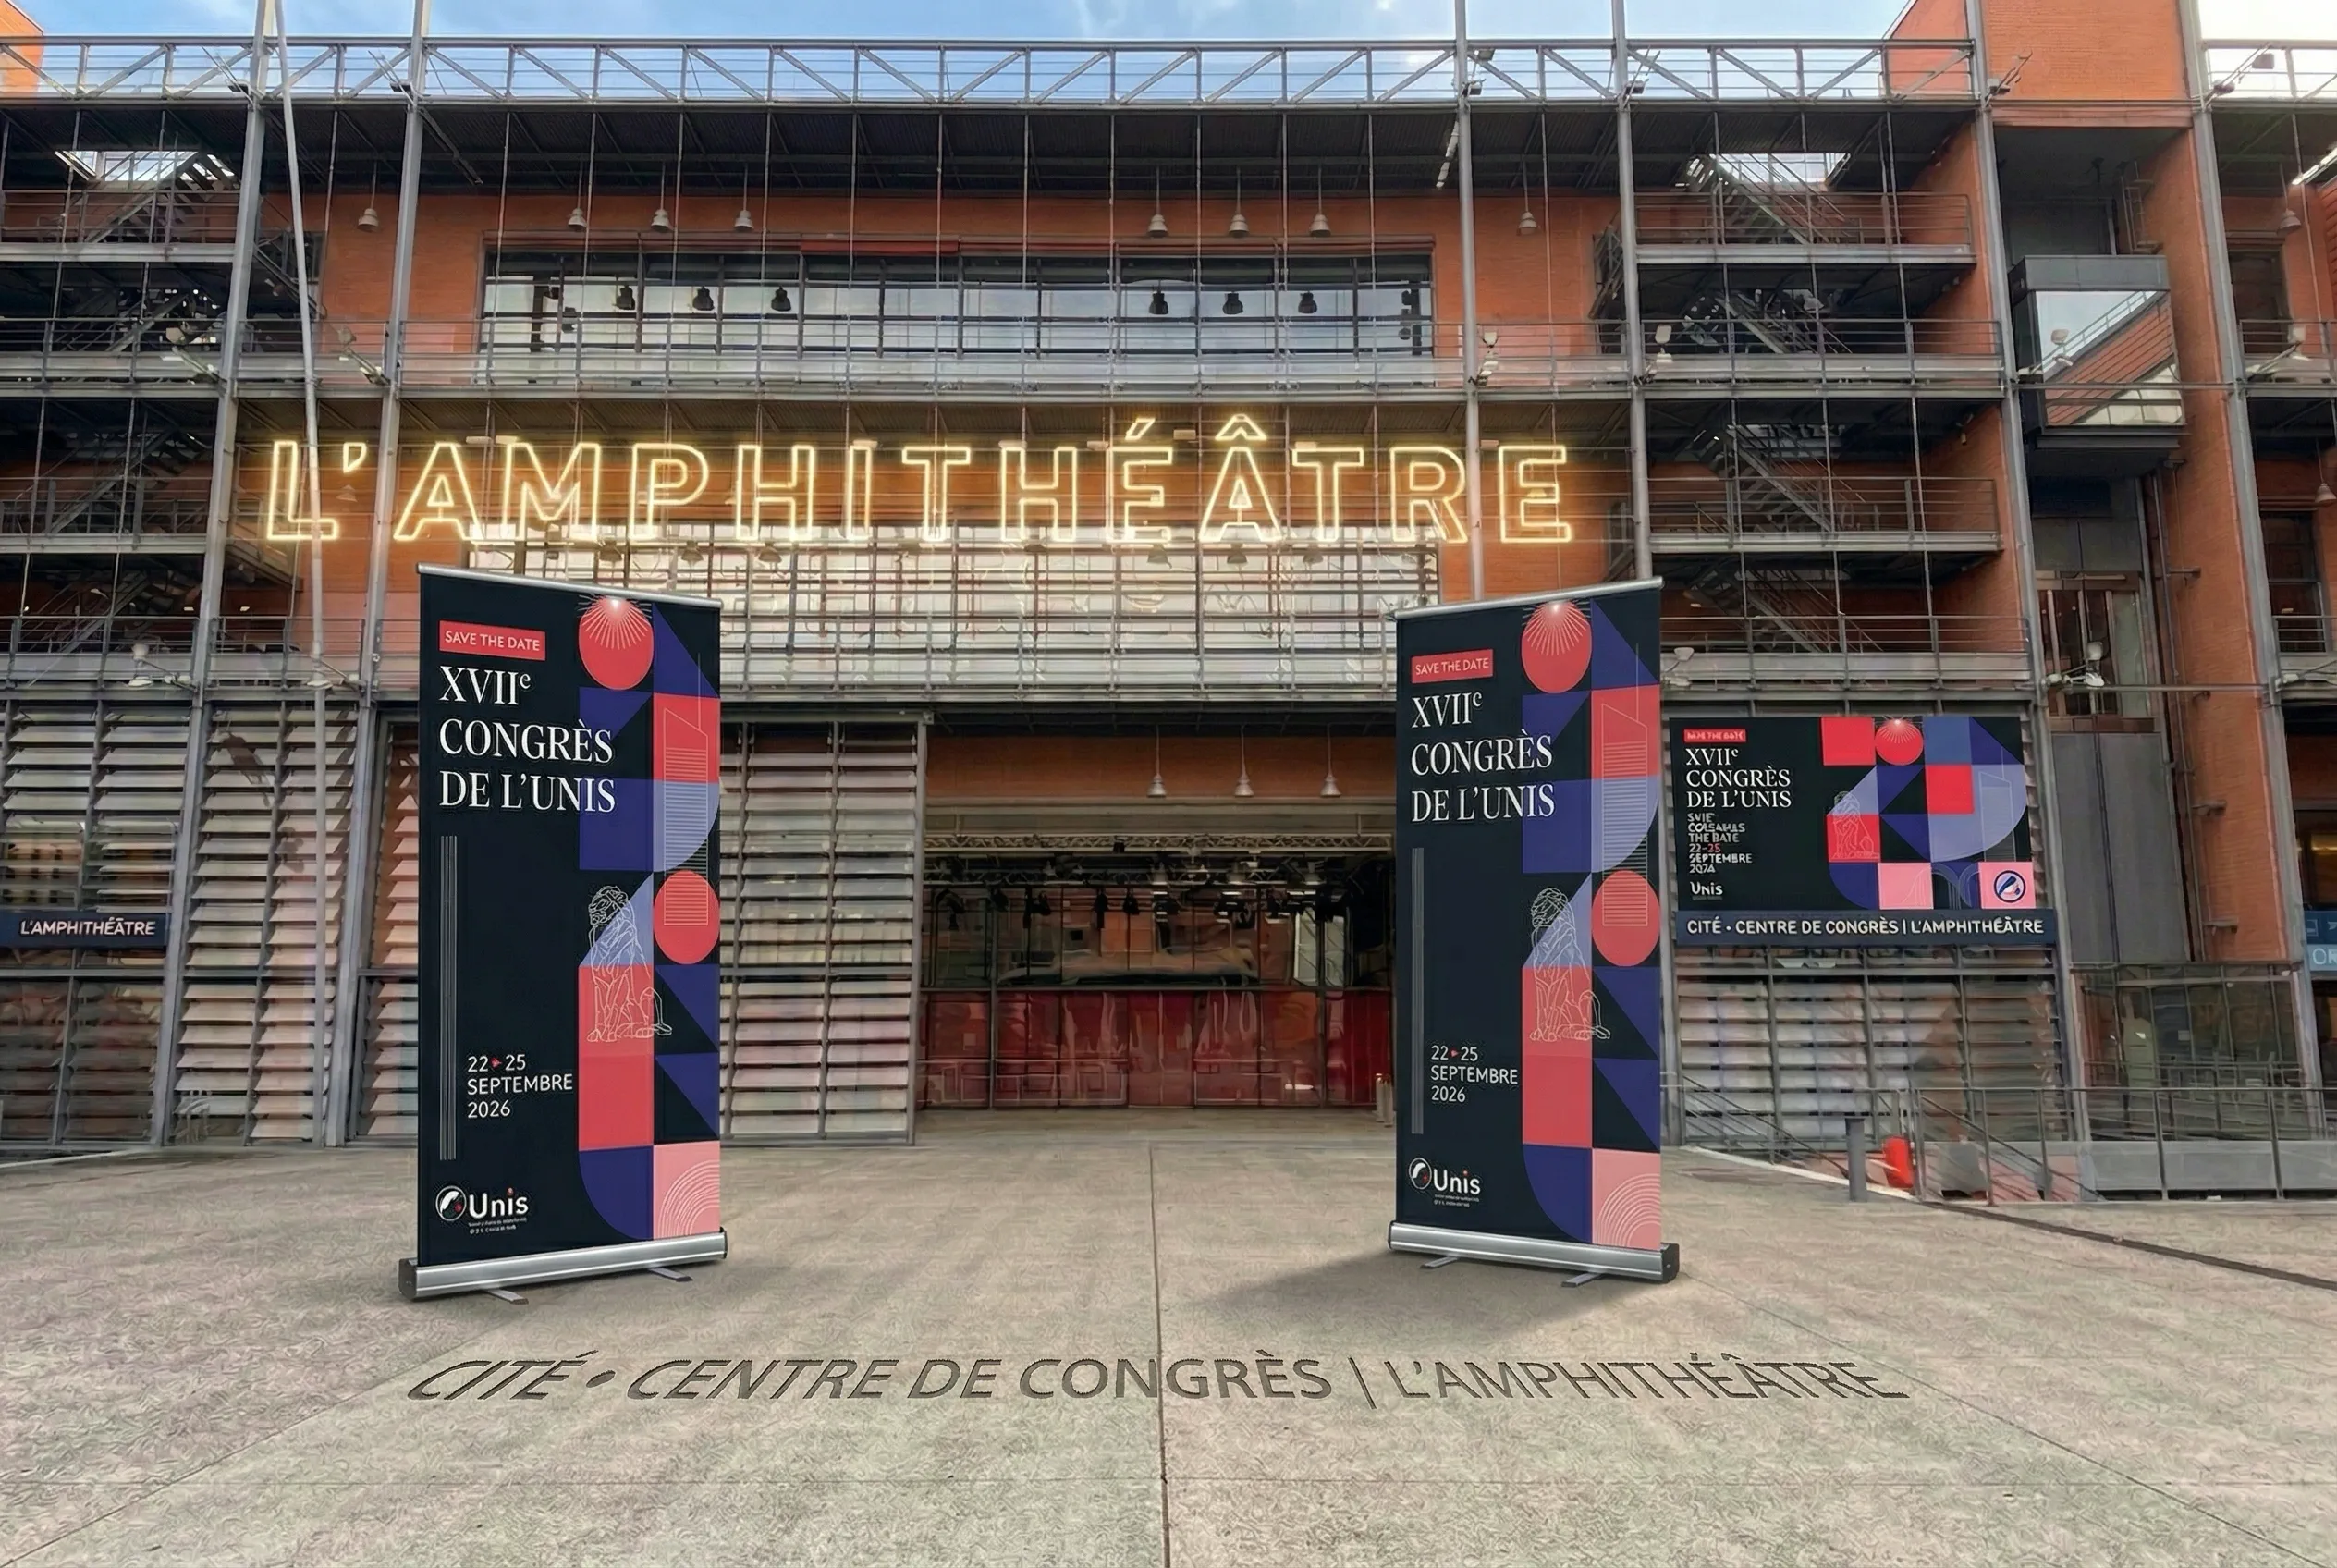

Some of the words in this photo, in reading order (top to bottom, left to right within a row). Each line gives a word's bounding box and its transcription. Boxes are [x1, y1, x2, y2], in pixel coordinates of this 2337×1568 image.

[265, 414, 1572, 544] L'AMPHITHÉÂTRE
[445, 631, 476, 645] SAVE
[480, 634, 504, 648] THE
[508, 637, 540, 651] DATE
[1415, 662, 1439, 676] SAVE
[1441, 659, 1461, 672] THE
[1462, 657, 1489, 671] DATE
[439, 665, 532, 705] XVIIe
[439, 718, 613, 764] CONGRÈS
[1411, 729, 1553, 776] CONGRÈS
[1685, 765, 1792, 788] CONGRÈS
[439, 770, 490, 807] DE
[501, 773, 616, 813] L'UNIS
[1686, 790, 1716, 808] DE
[1721, 790, 1792, 808] L'UNIS
[1412, 790, 1450, 822] DE
[1457, 783, 1555, 820] L'UNIS
[1688, 833, 1710, 843] THE
[1689, 853, 1753, 864] SEPTEMBRE
[1687, 916, 1721, 934] CITÉ
[1735, 921, 1797, 935] CENTRE
[1801, 921, 1822, 935] DE
[1826, 916, 1899, 935] CONGRÈS
[468, 1056, 489, 1072] 22
[505, 1054, 526, 1071] 25
[1431, 1045, 1449, 1060] 22
[1461, 1046, 1478, 1061] 25
[467, 1073, 573, 1095] SEPTEMBRE
[1430, 1065, 1518, 1084] SEPTEMBRE
[1431, 1085, 1466, 1102] 2026
[468, 1099, 510, 1118] 2026
[1433, 1169, 1481, 1194] Unis
[469, 1187, 529, 1219] Unis
[408, 1350, 598, 1400] CITÉ
[627, 1359, 897, 1400] CENTRE
[907, 1359, 1002, 1398] DE
[1020, 1349, 1333, 1399] CONGRÈS
[1385, 1352, 1910, 1399] L'AMPHITHÉÂTRE
